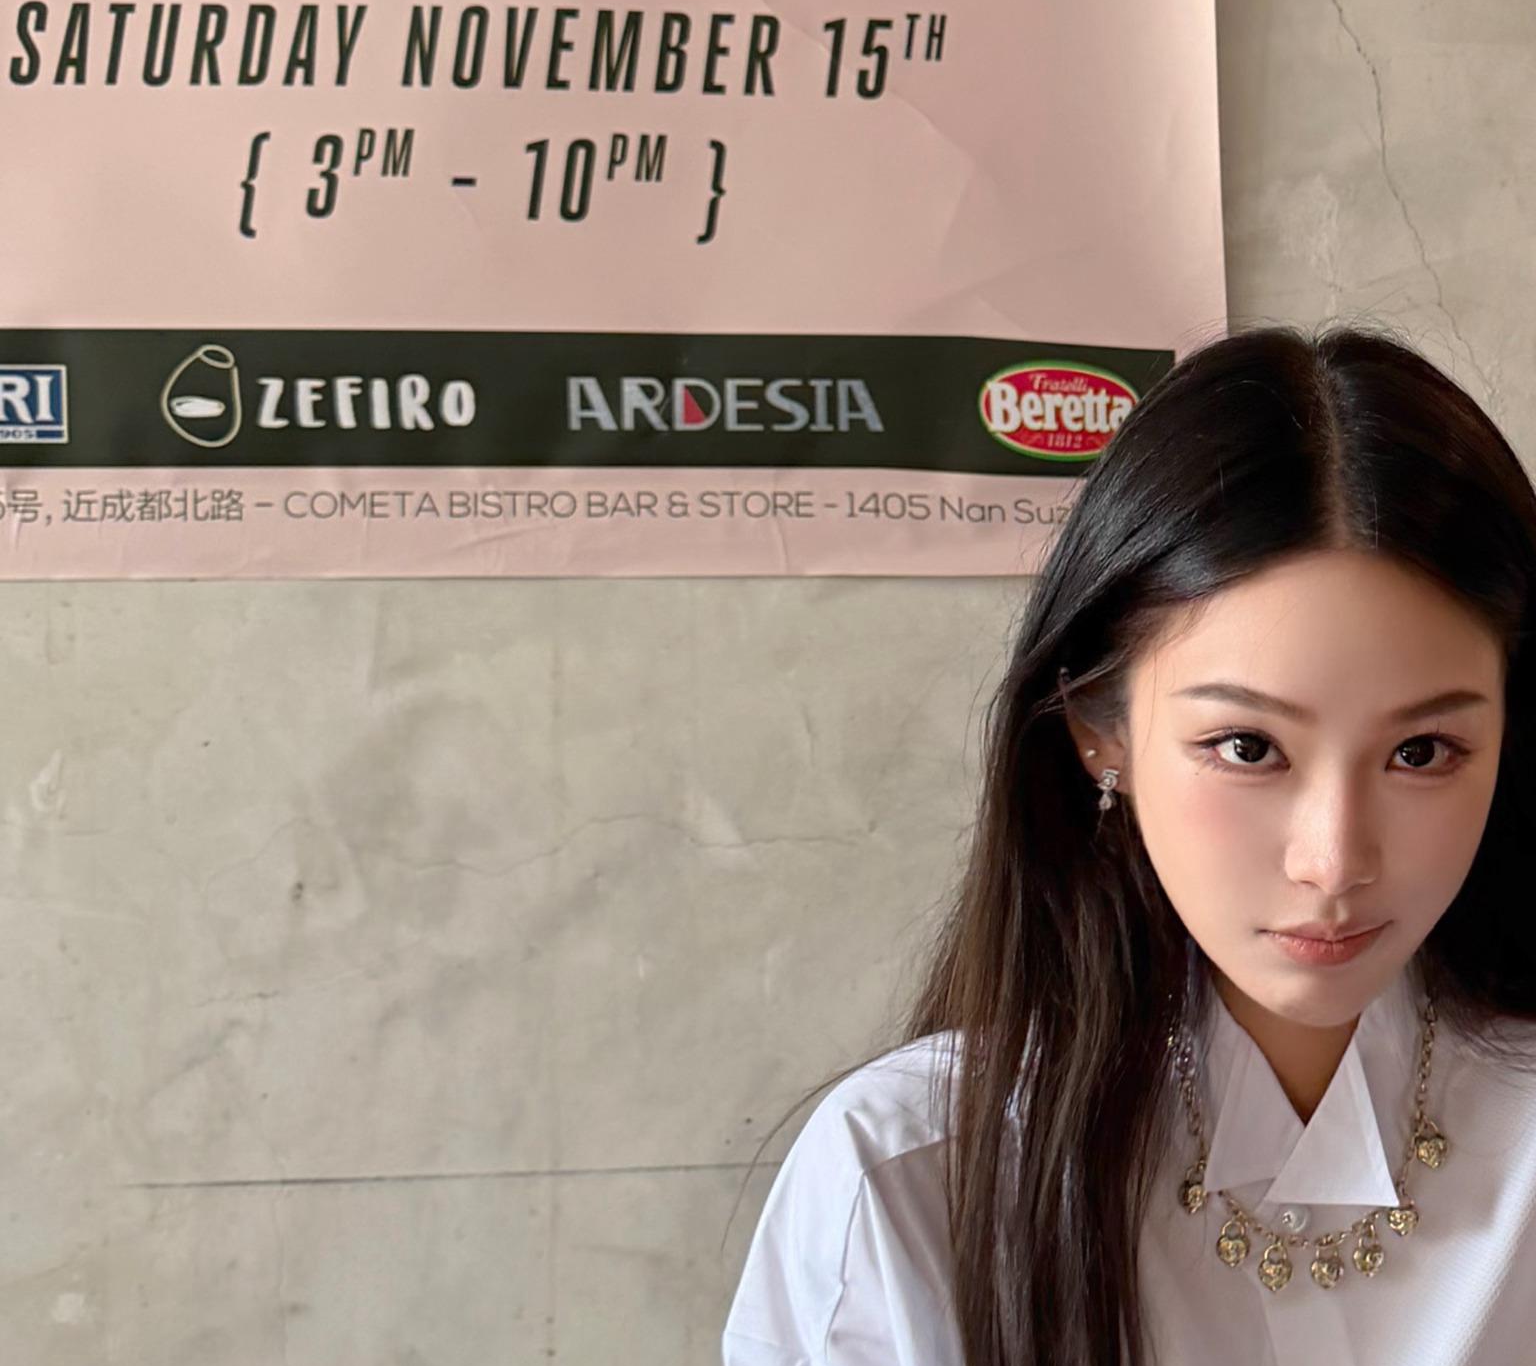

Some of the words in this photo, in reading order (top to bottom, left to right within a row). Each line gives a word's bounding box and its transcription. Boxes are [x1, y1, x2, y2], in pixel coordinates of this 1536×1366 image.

[10, 1, 367, 86] SATURDAY
[402, 6, 777, 95] NOVEMBER
[824, 14, 946, 99] 15TH
[306, 129, 414, 218] 3PM
[526, 134, 667, 221] 10PM
[257, 375, 476, 430] ZEFIRO
[568, 377, 884, 432] ARDESIA
[987, 381, 1133, 434] Beretta
[284, 491, 440, 518] COMETA
[449, 491, 577, 518] BISTRO
[587, 491, 658, 518] BAR
[667, 491, 689, 518] &
[698, 491, 815, 518] STORE
[847, 491, 931, 520] 1405
[940, 496, 1006, 523] Nan
